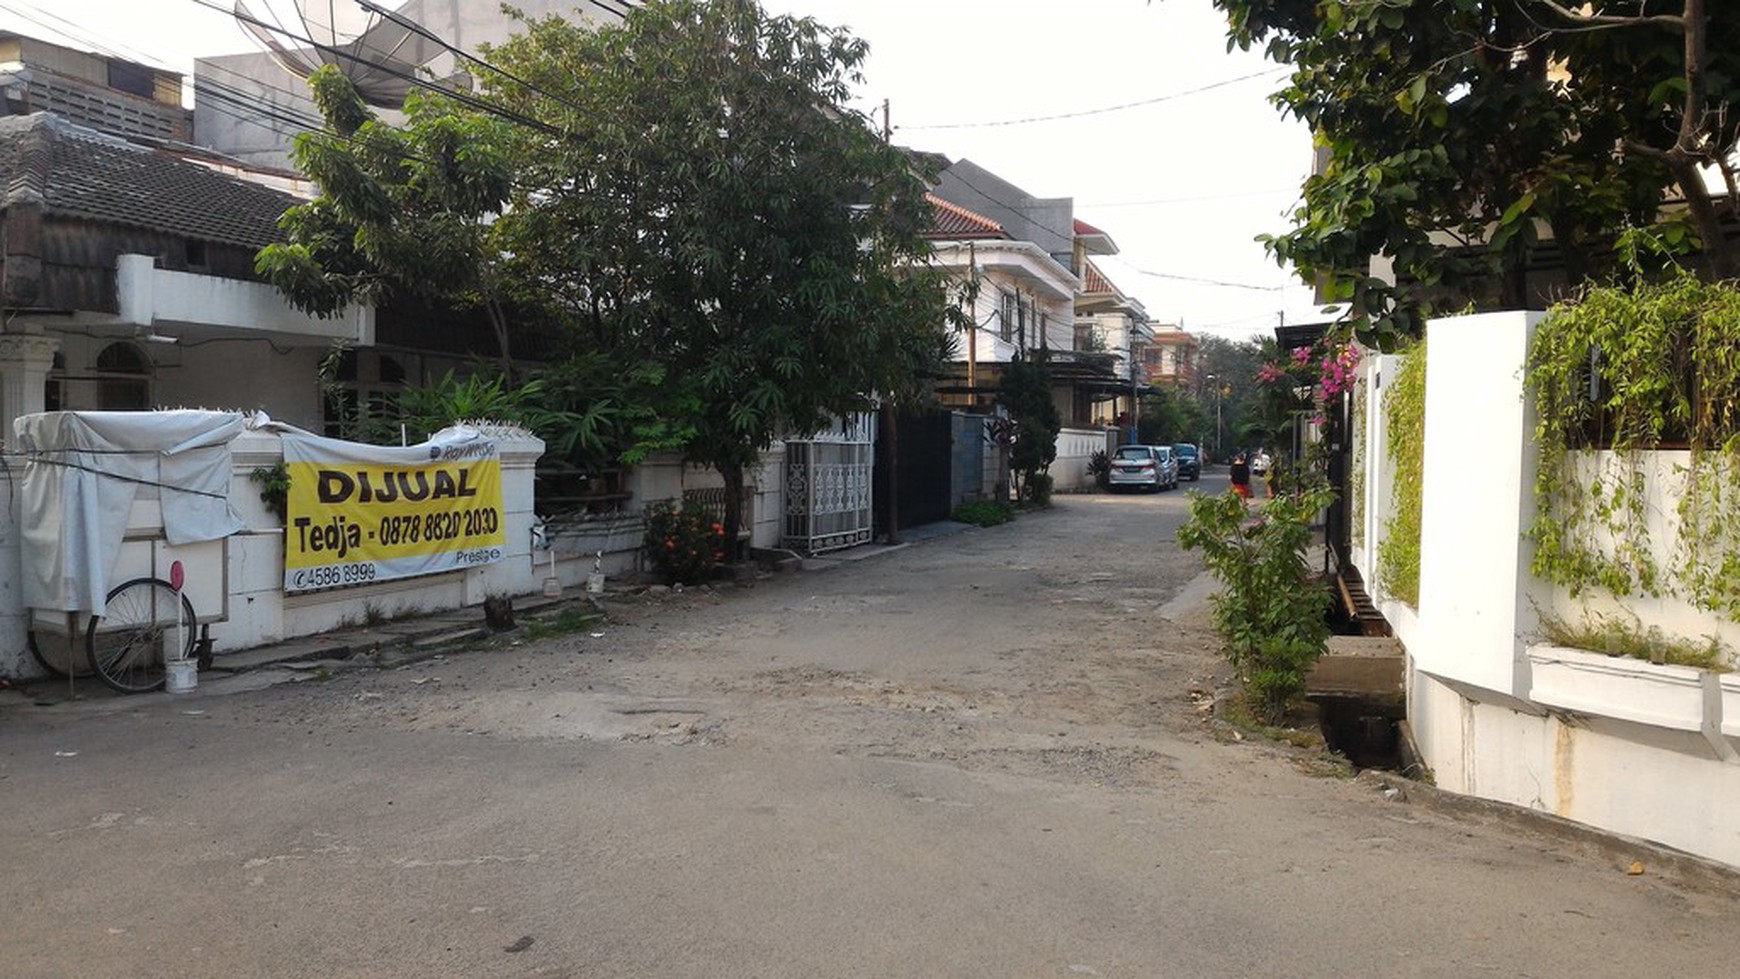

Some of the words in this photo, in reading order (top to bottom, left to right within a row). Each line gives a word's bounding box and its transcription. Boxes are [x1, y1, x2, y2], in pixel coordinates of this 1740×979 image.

[318, 468, 476, 503] DIJUAL
[295, 515, 360, 558] Tedja
[380, 514, 420, 545] 0878
[423, 511, 461, 541] 8820
[465, 507, 498, 536] 2030
[307, 566, 341, 586] 4586
[343, 563, 376, 582] 8999
